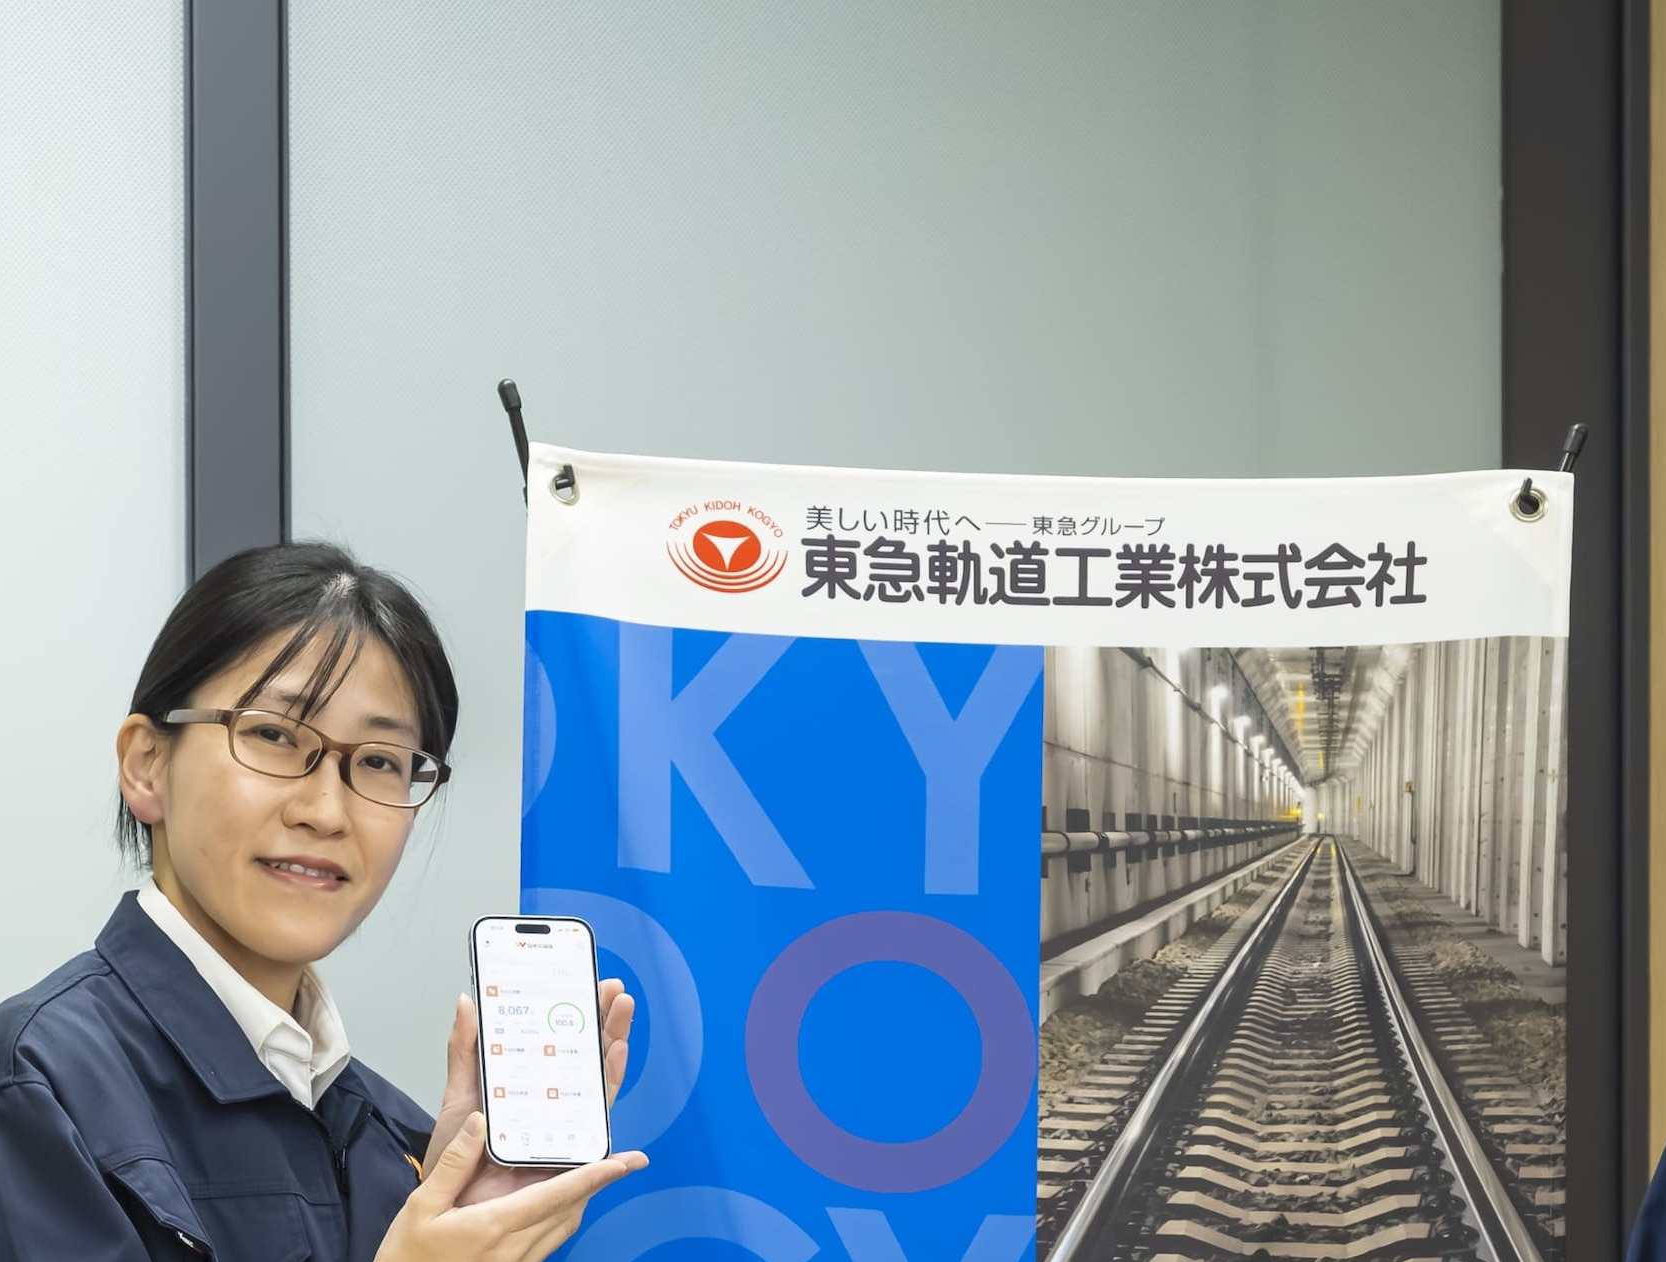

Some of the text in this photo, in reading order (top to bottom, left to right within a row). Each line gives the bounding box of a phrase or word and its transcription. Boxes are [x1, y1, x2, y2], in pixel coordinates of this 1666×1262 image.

[669, 500, 784, 538] TOKYU KIDOH KOGYO
[806, 504, 1165, 537] 美しい時代へ 東急グループ
[801, 534, 1428, 609] 東急軌道工業株式会社
[522, 622, 1044, 895] KY
[497, 1005, 530, 1016] 8,067
